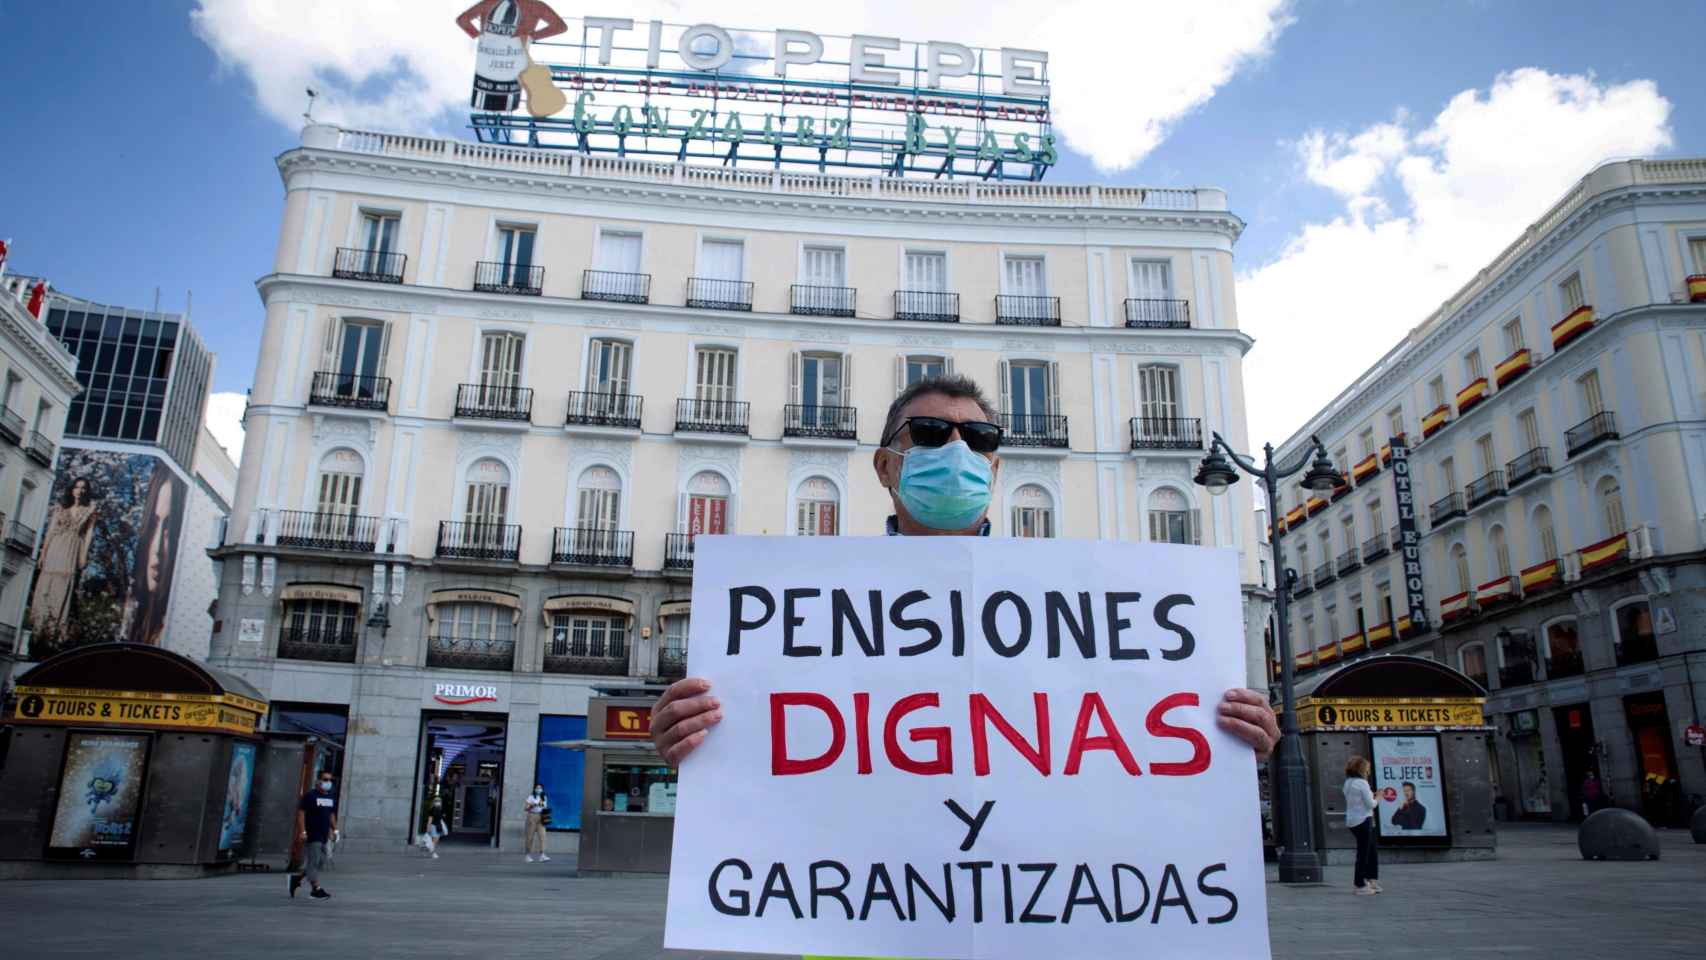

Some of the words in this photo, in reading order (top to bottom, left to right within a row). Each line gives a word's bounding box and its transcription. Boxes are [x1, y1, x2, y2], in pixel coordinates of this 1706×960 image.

[570, 76, 620, 91] SOL
[638, 79, 672, 95] DE
[583, 15, 735, 70] TIO
[775, 28, 1050, 97] PEPE
[573, 92, 848, 149] GONZALEZ
[904, 113, 1058, 165] BYASS
[1393, 447, 1414, 519] HOTEL
[1403, 531, 1425, 623] EUROPA
[726, 585, 1196, 660] PENSIONES
[47, 700, 96, 717] TOURS
[100, 703, 112, 717] &
[119, 704, 181, 721] TICKETS
[434, 683, 497, 698] PRIMOR
[1340, 709, 1380, 722] TOURS
[1384, 709, 1393, 722] &
[1398, 708, 1450, 722] TICKETS
[770, 692, 1212, 777] DIGNAS
[1383, 766, 1396, 780] EL
[1399, 766, 1425, 780] JEFE
[944, 798, 996, 852] Y
[708, 858, 1239, 925] GARANTIZADAS
